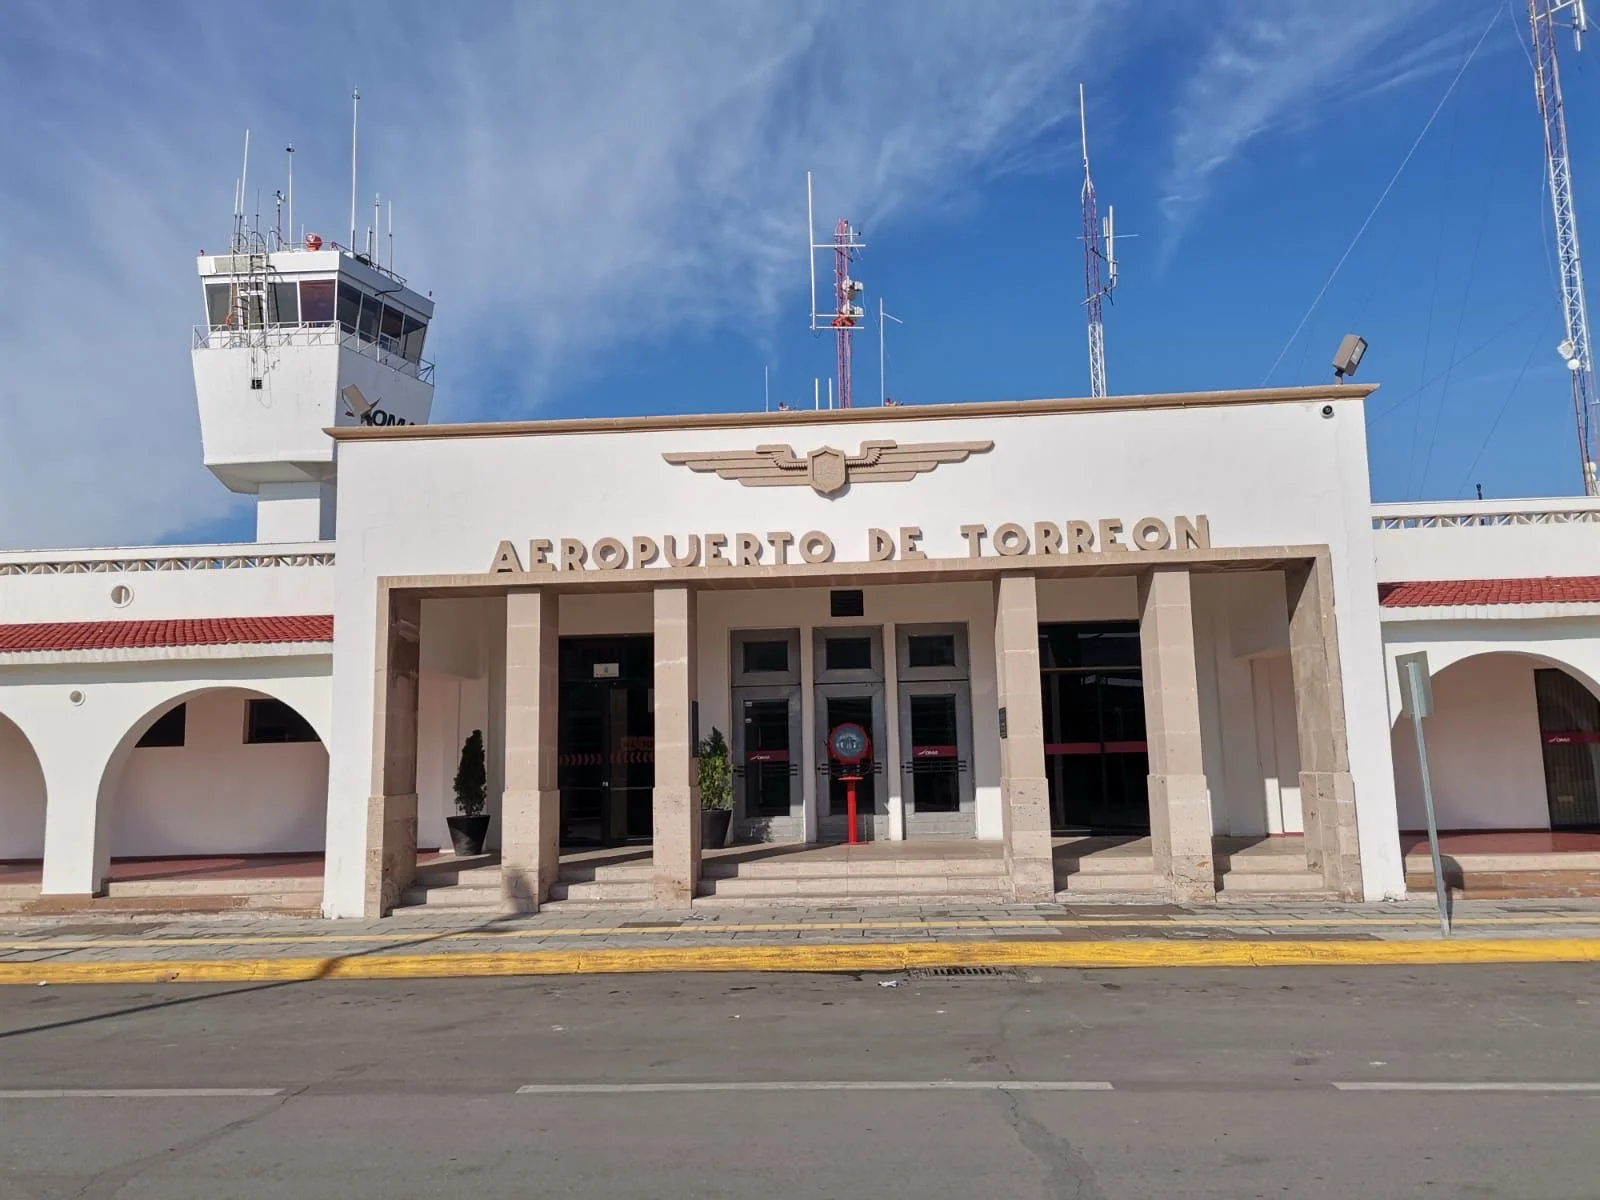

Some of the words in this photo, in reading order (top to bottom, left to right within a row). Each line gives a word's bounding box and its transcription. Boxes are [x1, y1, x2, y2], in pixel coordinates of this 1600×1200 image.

[489, 530, 835, 572] AEROPUERTO
[868, 526, 926, 561] DE
[960, 514, 1211, 557] TORREON
